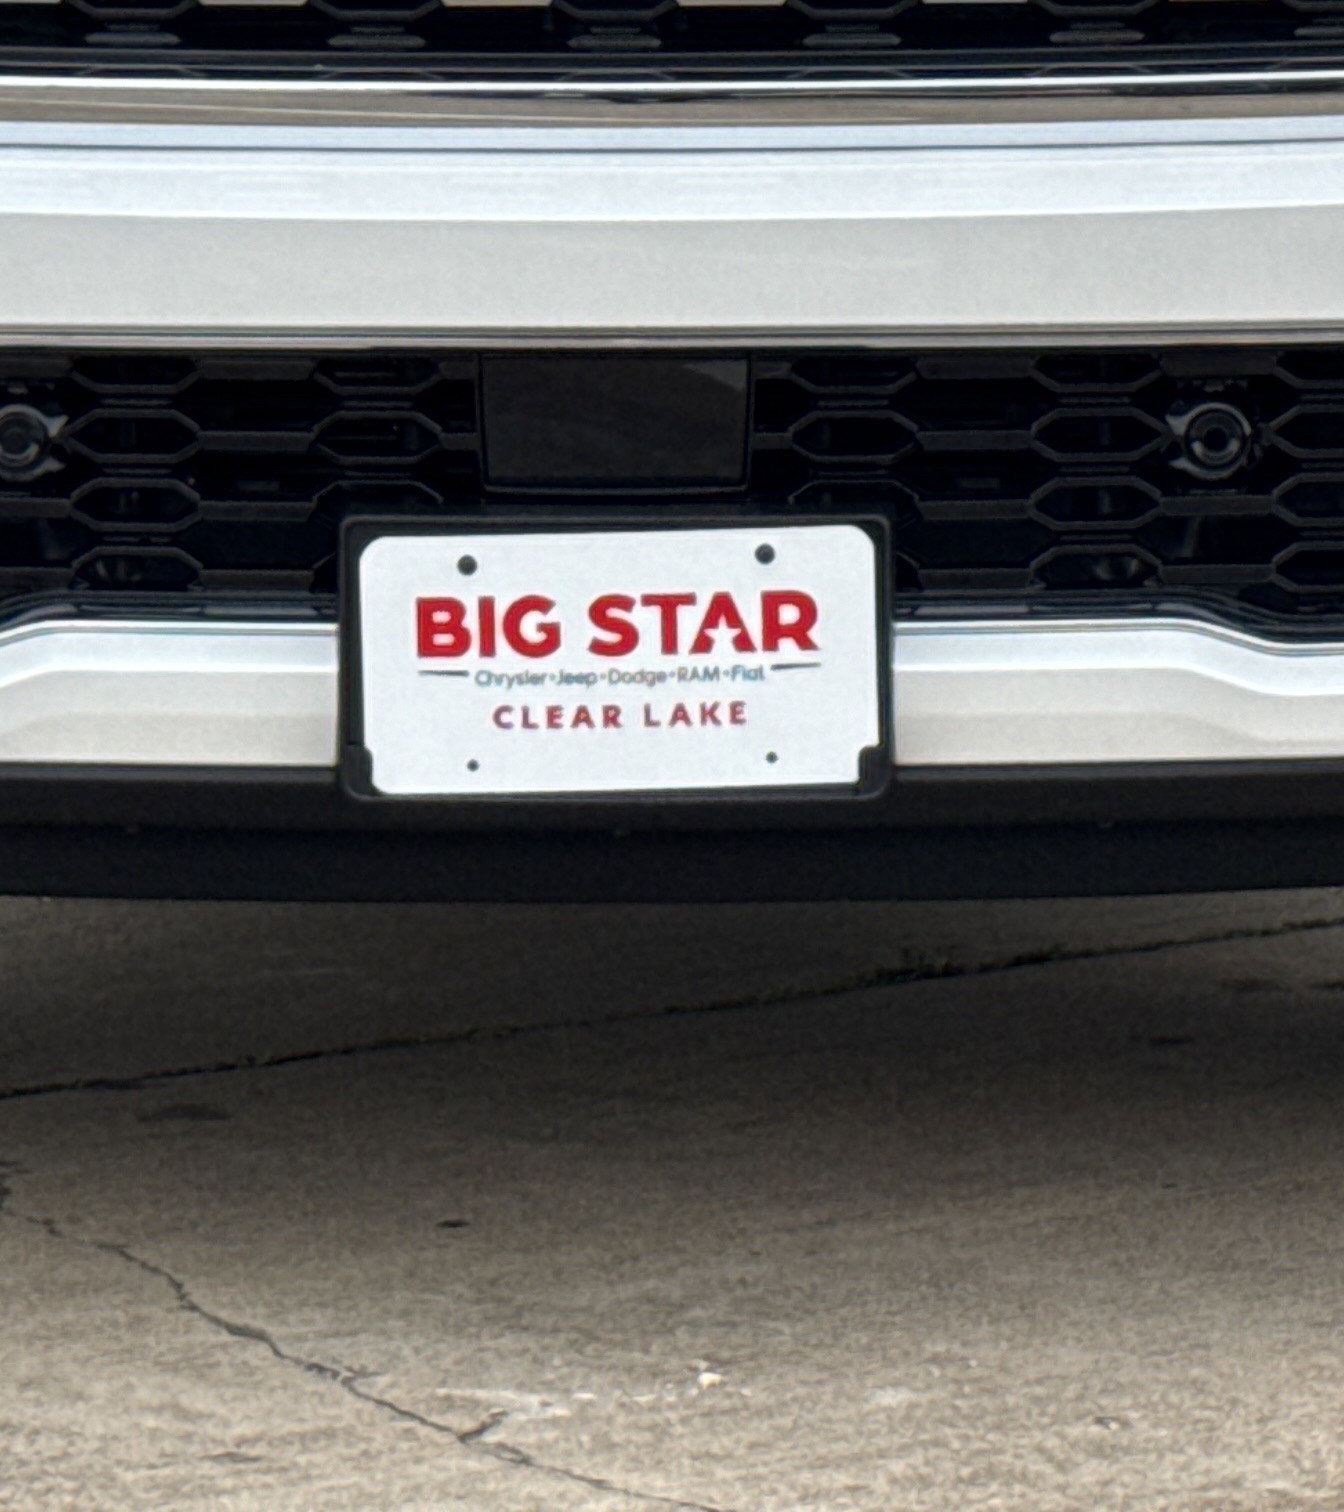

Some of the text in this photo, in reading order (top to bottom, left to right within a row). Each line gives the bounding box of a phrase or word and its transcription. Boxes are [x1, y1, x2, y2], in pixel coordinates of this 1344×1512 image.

[415, 590, 819, 659] BIG STAR
[492, 700, 747, 730] CLEAR LAKE
